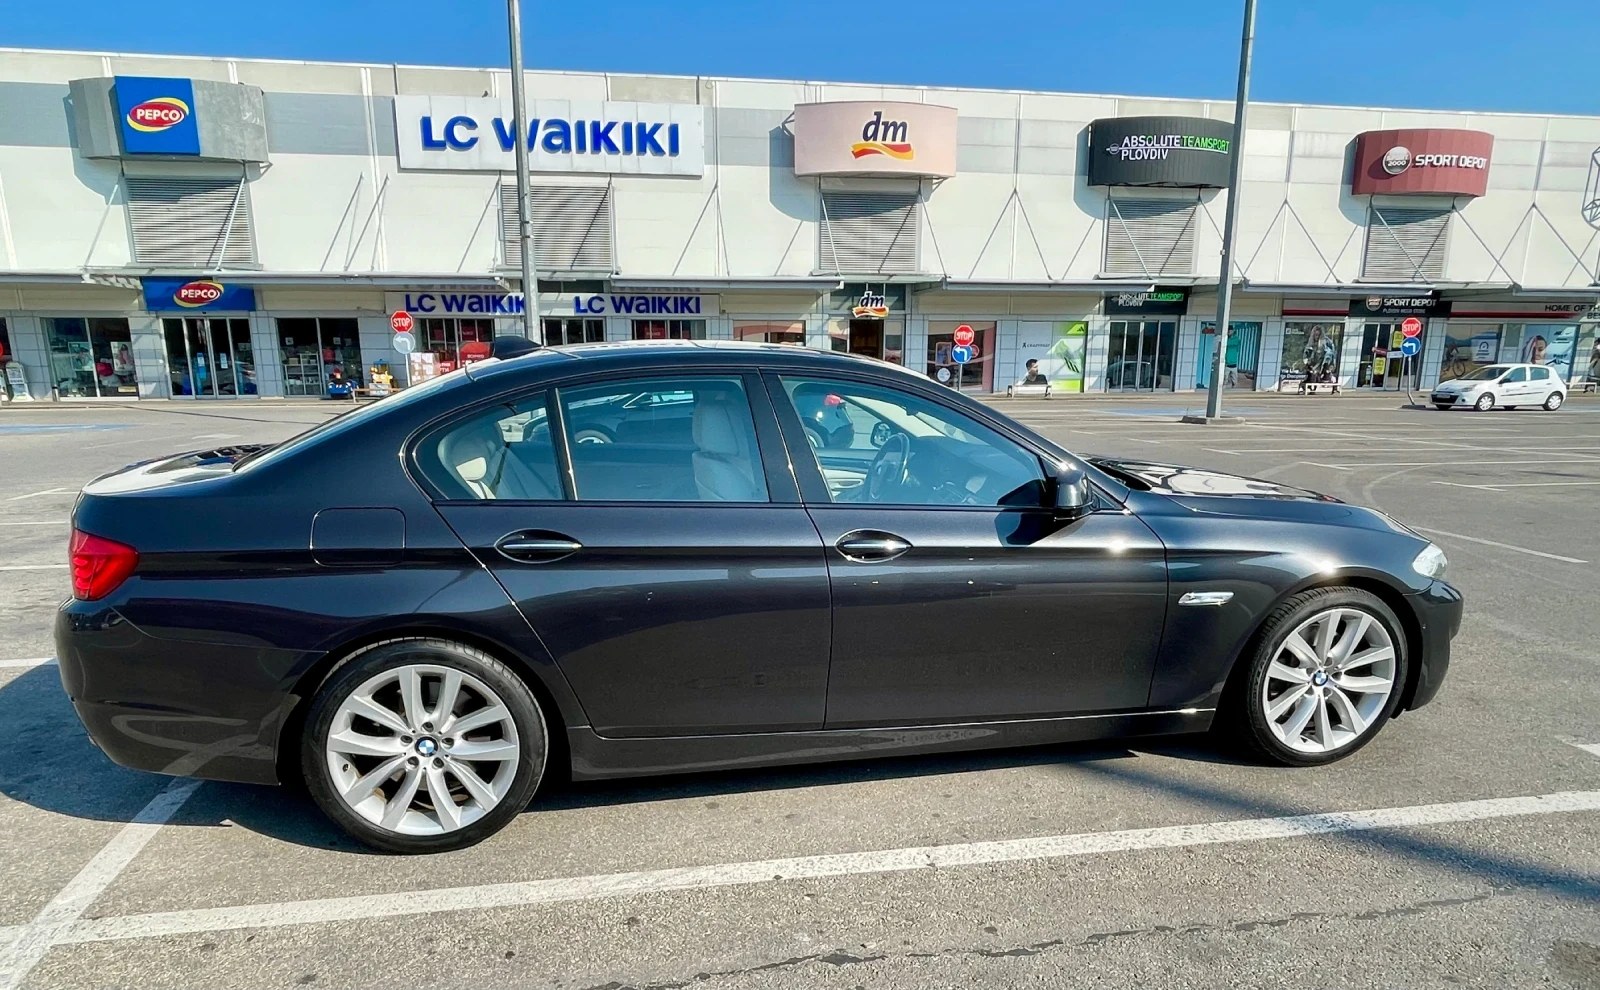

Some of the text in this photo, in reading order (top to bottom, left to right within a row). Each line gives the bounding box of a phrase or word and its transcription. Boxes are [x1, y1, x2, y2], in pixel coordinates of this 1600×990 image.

[136, 109, 180, 121] PEPCO
[862, 111, 907, 142] dm
[419, 115, 479, 152] LC
[1121, 135, 1230, 152] ABSOLUTE TEAMSPORT
[1121, 148, 1169, 160] PLOVDIV
[1415, 154, 1488, 169] SPORT DEPOT
[181, 289, 217, 299] PEPCO
[860, 292, 884, 307] dm
[405, 294, 436, 312] LC
[574, 295, 605, 314] LC
[1383, 298, 1410, 306] SPORT
[1411, 298, 1437, 306] DEPOT
[1545, 304, 1600, 312] HOME OF TH
[393, 317, 411, 328] STOP
[1402, 323, 1419, 332] STOP
[955, 331, 972, 340] STOP
